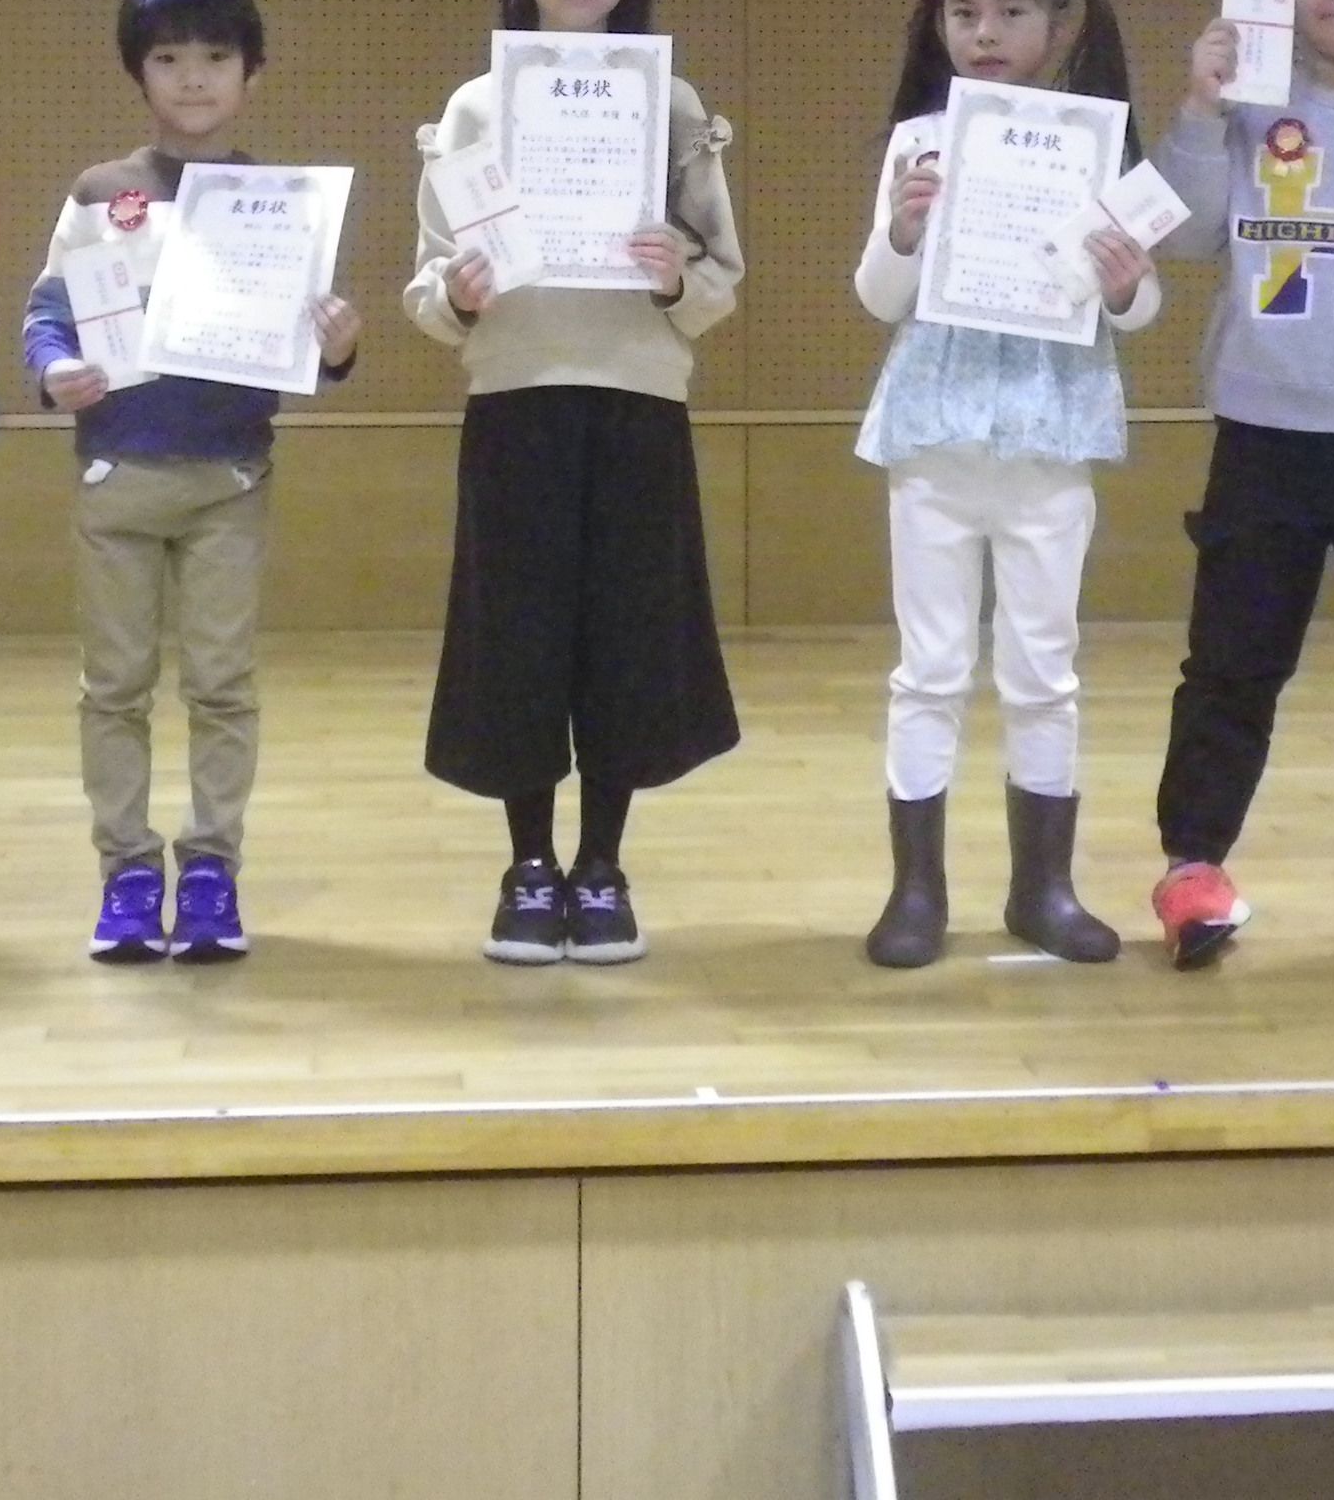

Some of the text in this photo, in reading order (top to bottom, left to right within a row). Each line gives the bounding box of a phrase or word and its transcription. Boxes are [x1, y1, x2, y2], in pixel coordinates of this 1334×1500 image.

[550, 78, 613, 98] 表彰状
[1001, 128, 1062, 152] 表彰状
[229, 199, 287, 215] 表彰状
